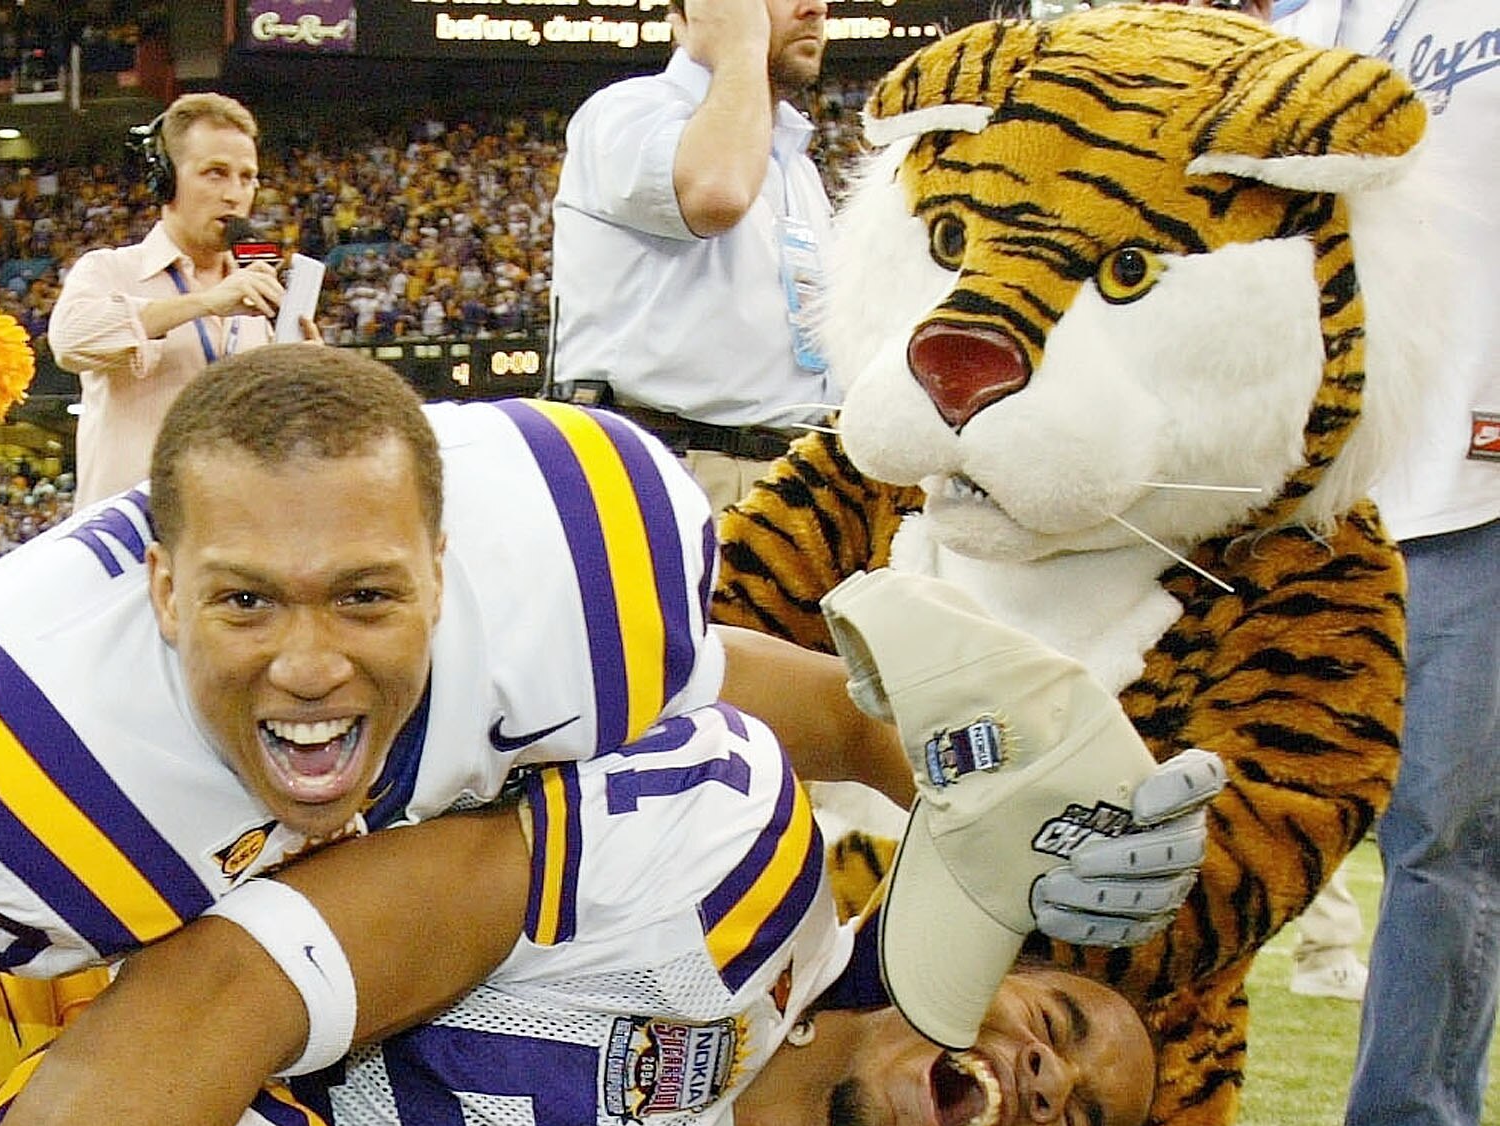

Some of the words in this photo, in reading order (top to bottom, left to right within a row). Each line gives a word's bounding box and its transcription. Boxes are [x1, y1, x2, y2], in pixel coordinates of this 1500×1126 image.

[436, 13, 541, 46] before,
[543, 15, 639, 48] during
[687, 1030, 714, 1105] NOKIA
